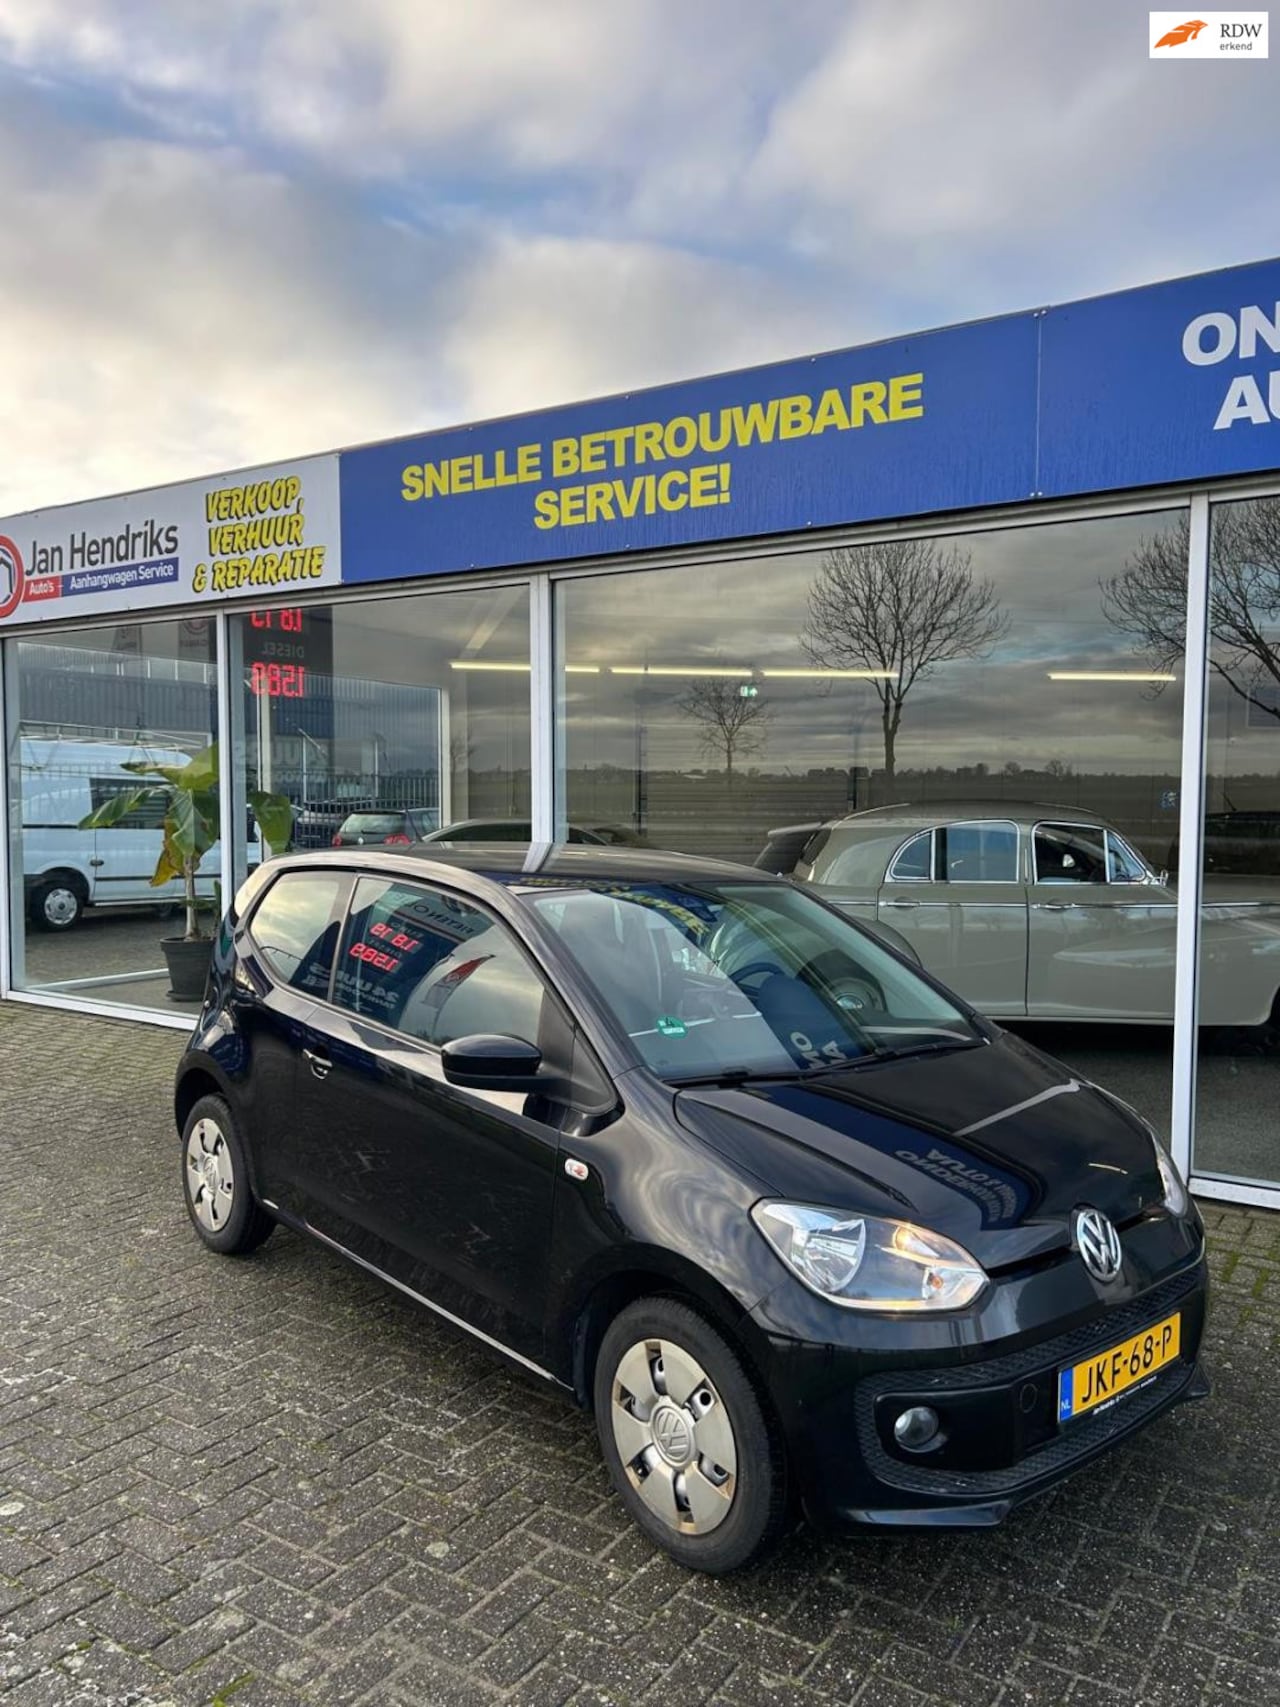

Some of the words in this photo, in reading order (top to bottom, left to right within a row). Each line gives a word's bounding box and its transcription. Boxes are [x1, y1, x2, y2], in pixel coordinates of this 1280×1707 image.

[1182, 301, 1280, 367] ON
[1213, 370, 1280, 430] A
[401, 443, 543, 501] SNELLE
[552, 373, 924, 478] BETROUWBARE
[206, 476, 304, 522] VERKOOP,
[533, 463, 732, 530] SERVICE!
[25, 540, 63, 576] Jan
[70, 519, 178, 569] Hendriks
[209, 513, 304, 556] VERHUUR
[29, 581, 54, 596] Auto's
[70, 571, 136, 590] Aanhangwagen
[138, 563, 174, 580] Service
[192, 563, 207, 593] &
[212, 546, 326, 592] REPARATIE
[1082, 1325, 1172, 1404] JKF-68-P
[1061, 1398, 1071, 1411] NL
